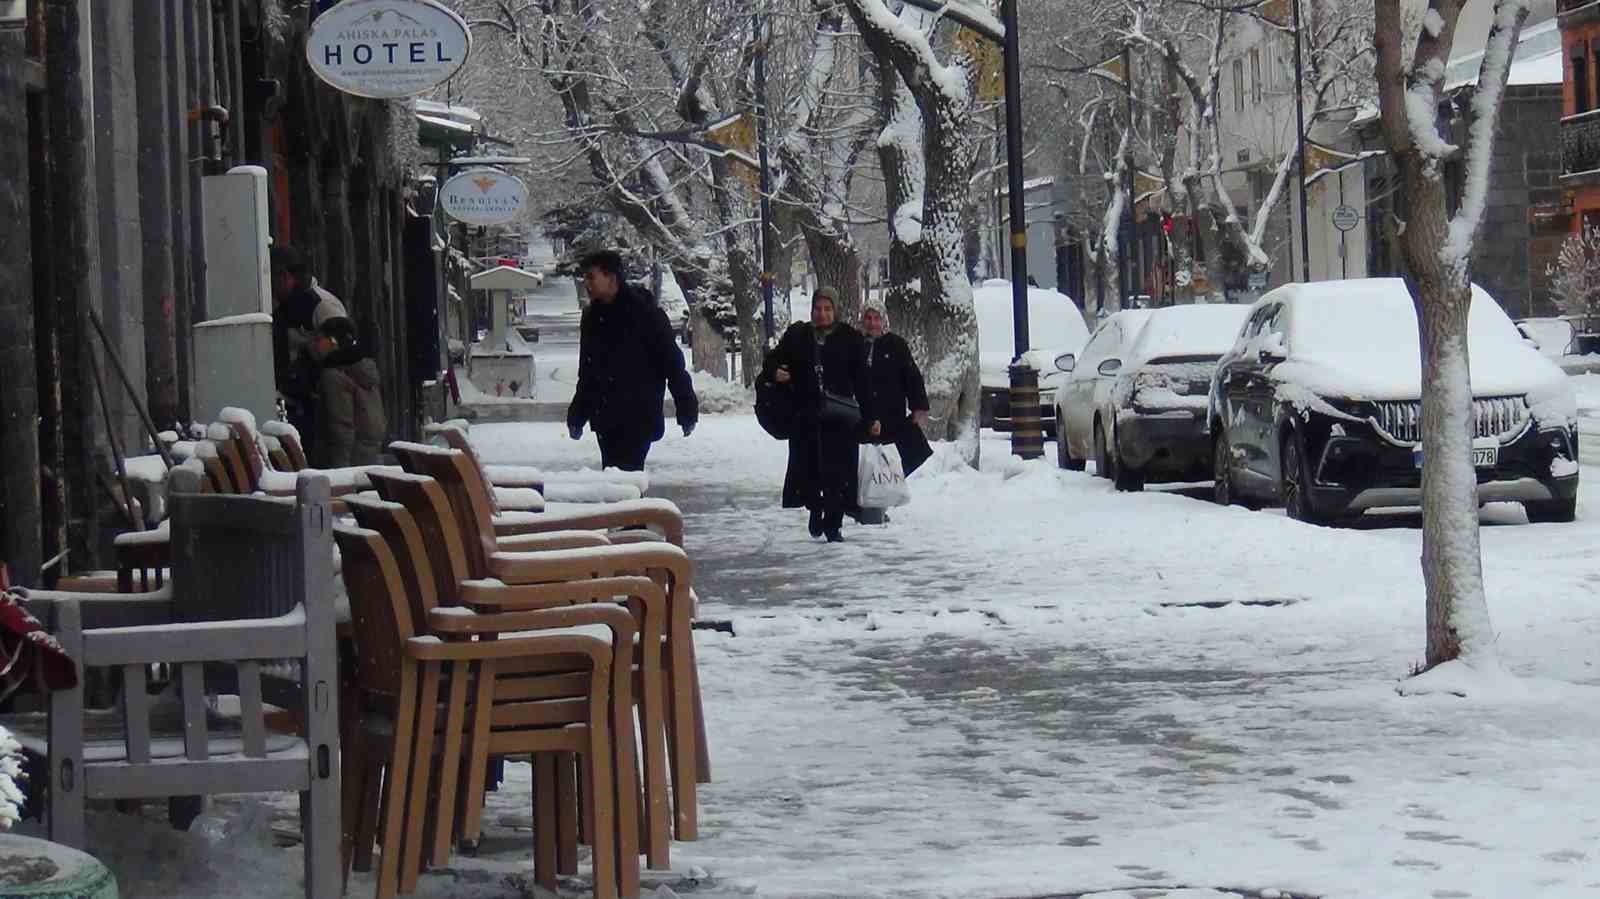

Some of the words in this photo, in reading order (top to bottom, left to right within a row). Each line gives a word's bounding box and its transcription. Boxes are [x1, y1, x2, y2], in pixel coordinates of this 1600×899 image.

[337, 29, 388, 40] AHISKA
[394, 28, 438, 39] PALAS
[324, 42, 452, 65] HOTEL
